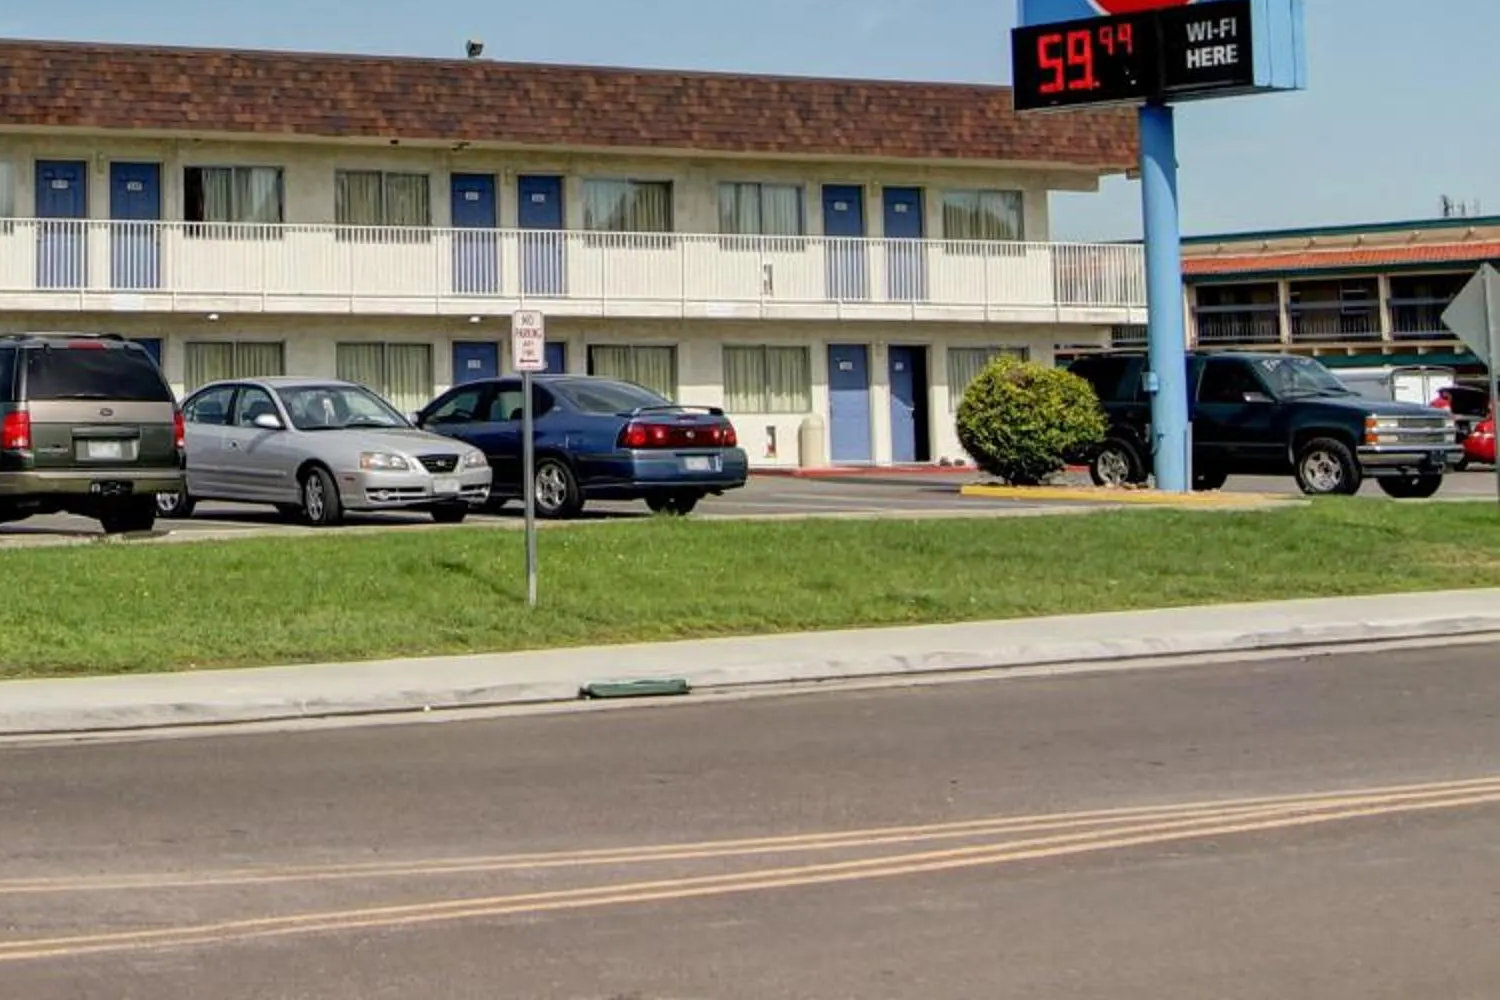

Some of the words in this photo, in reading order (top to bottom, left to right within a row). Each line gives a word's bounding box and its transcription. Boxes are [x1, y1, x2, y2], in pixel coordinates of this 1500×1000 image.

[1186, 16, 1237, 43] WI-FI
[1037, 30, 1093, 92] 59
[1186, 43, 1239, 69] HERE
